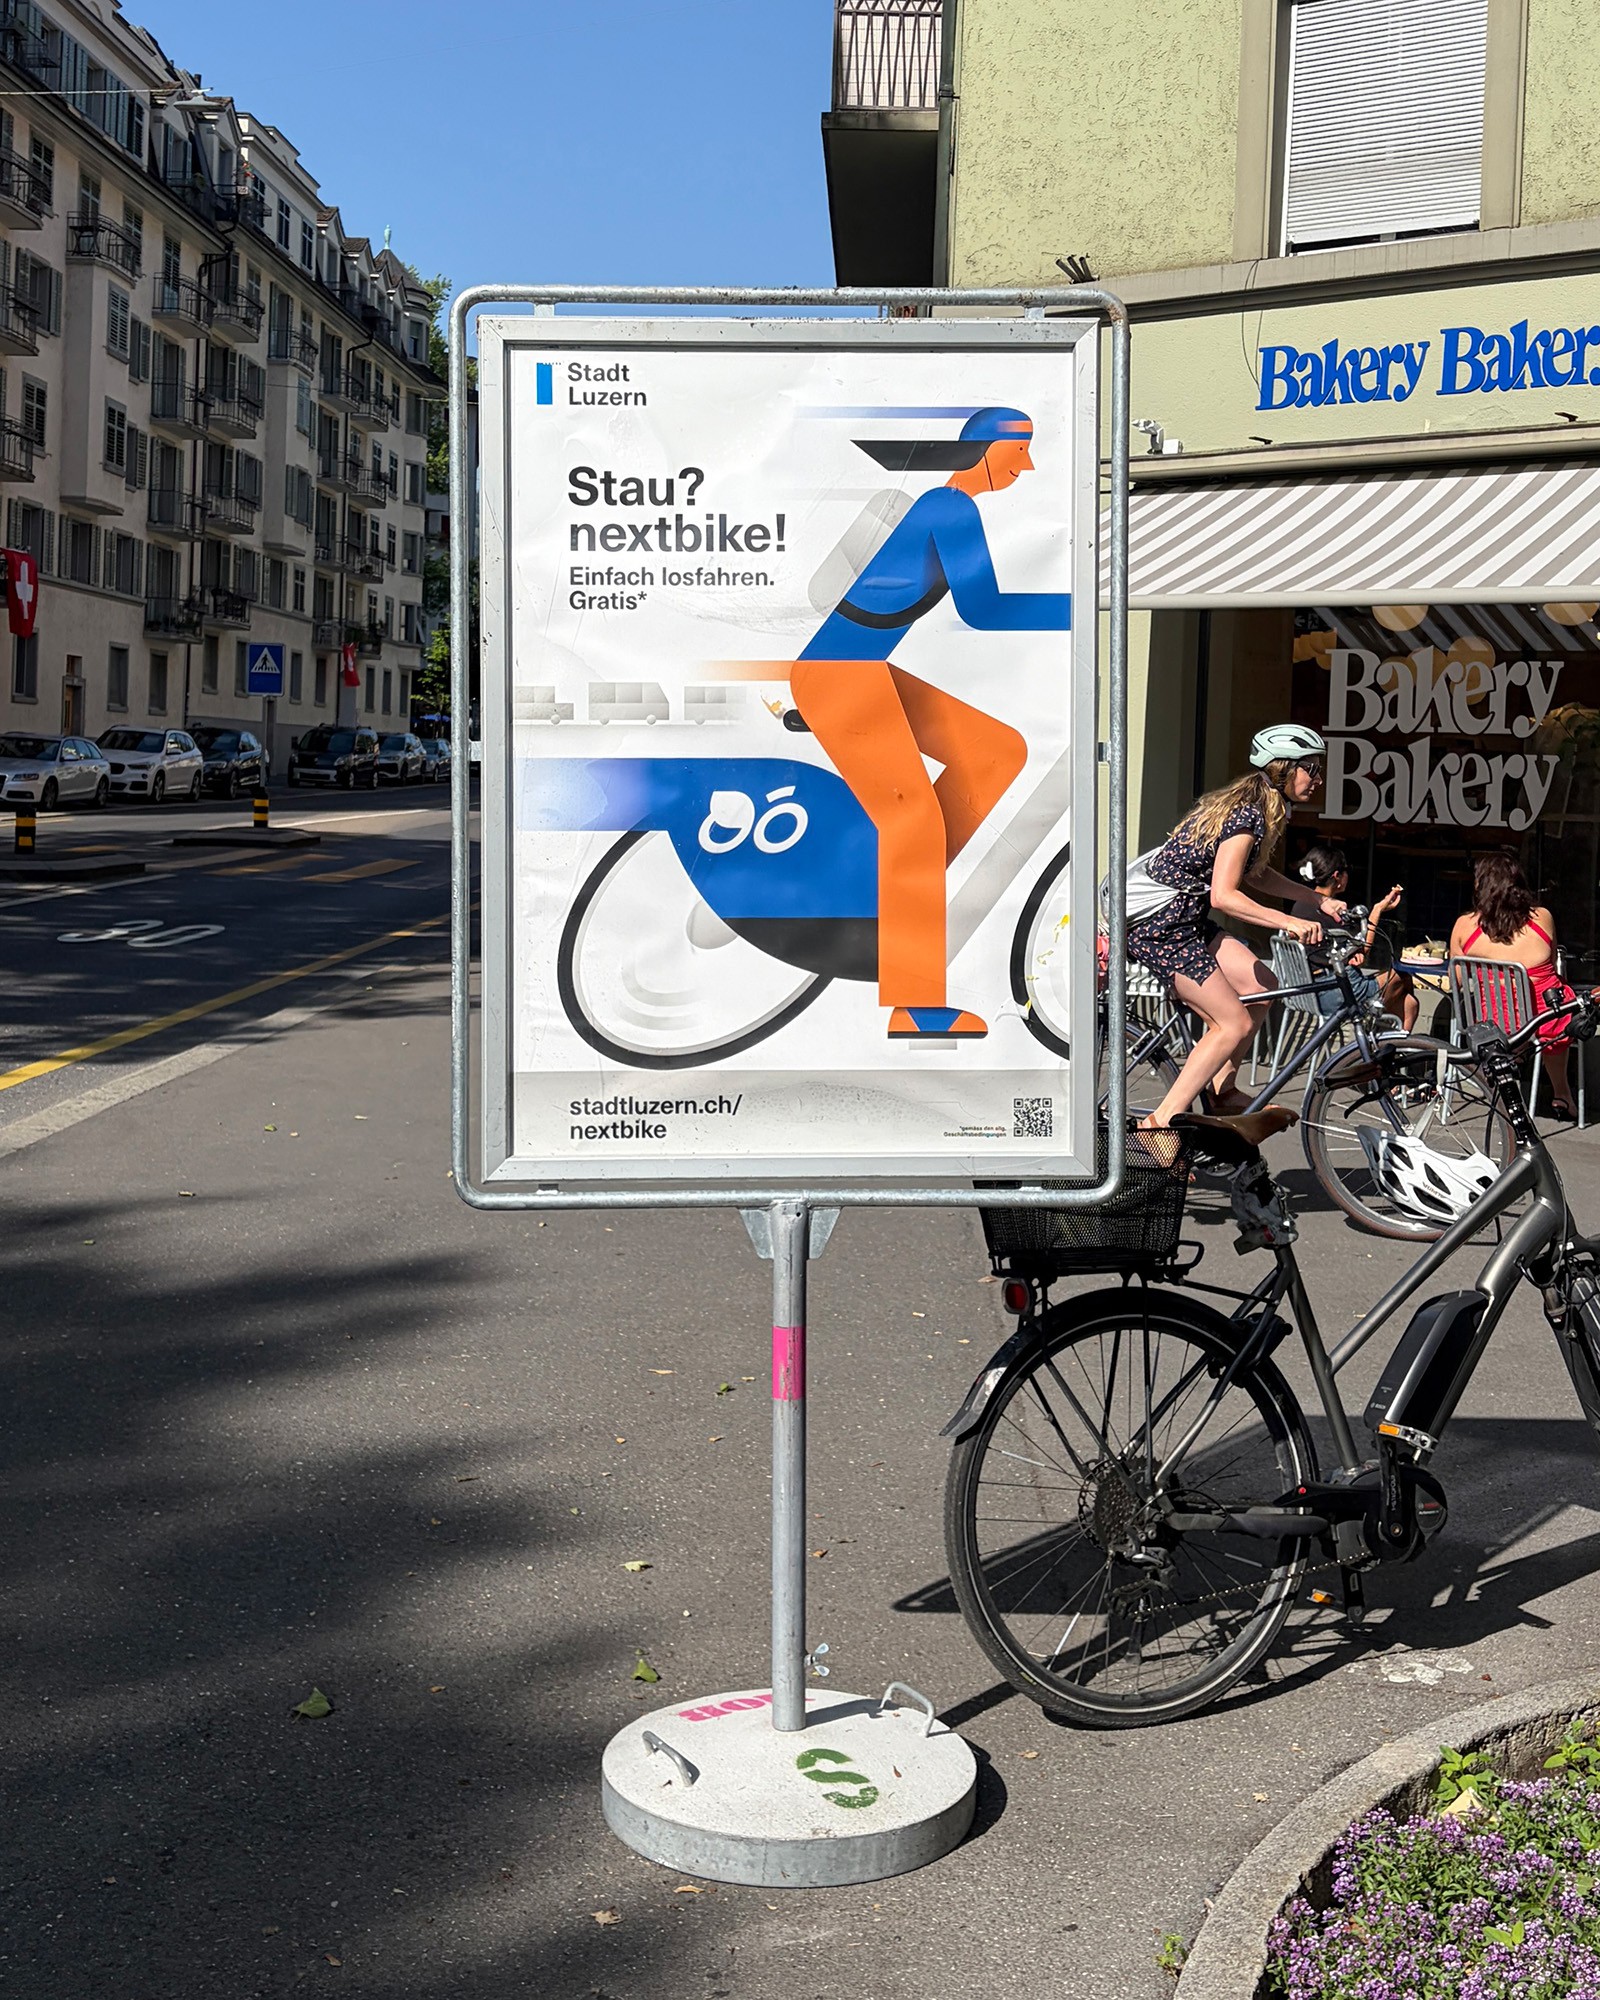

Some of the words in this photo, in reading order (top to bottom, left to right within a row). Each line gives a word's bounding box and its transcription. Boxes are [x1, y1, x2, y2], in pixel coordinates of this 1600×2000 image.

[567, 362, 630, 382] Stadt
[1255, 338, 1431, 411] Bakery
[568, 386, 647, 405] Luzern
[567, 465, 705, 506] Stau?
[569, 513, 786, 552] nextbike!
[569, 566, 654, 586] Einfach
[662, 567, 775, 586] losfahren.
[1322, 644, 1565, 738] Bakery
[1318, 736, 1560, 831] Bakery
[57, 919, 226, 947] 30
[569, 1094, 743, 1116] stadtluzern.ch/
[570, 1120, 667, 1140] nextbike
